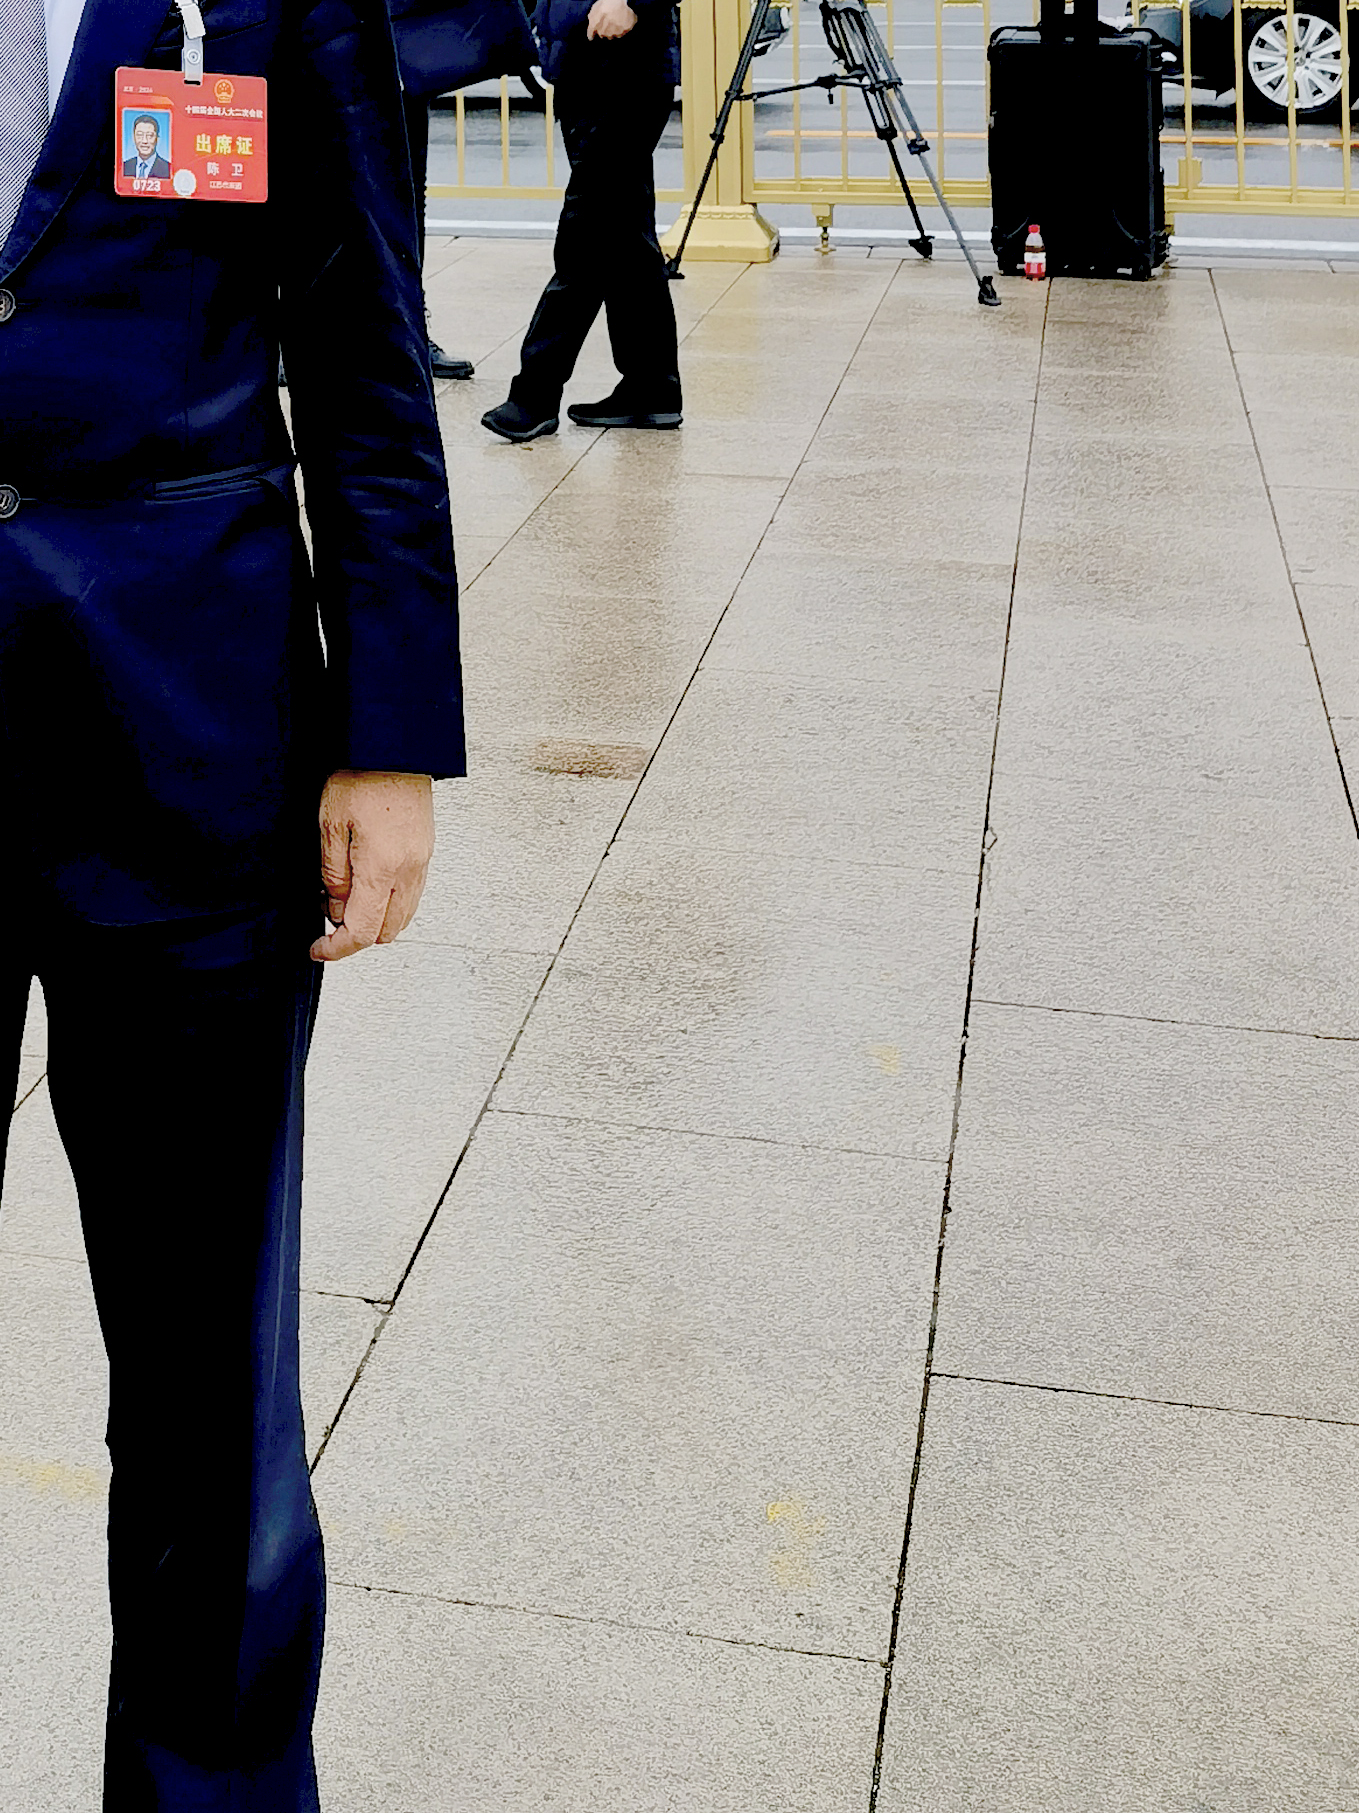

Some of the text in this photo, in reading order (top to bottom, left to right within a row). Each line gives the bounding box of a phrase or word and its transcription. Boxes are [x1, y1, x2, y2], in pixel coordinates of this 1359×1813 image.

[196, 133, 253, 155] 出席证
[133, 179, 161, 193] 0723
